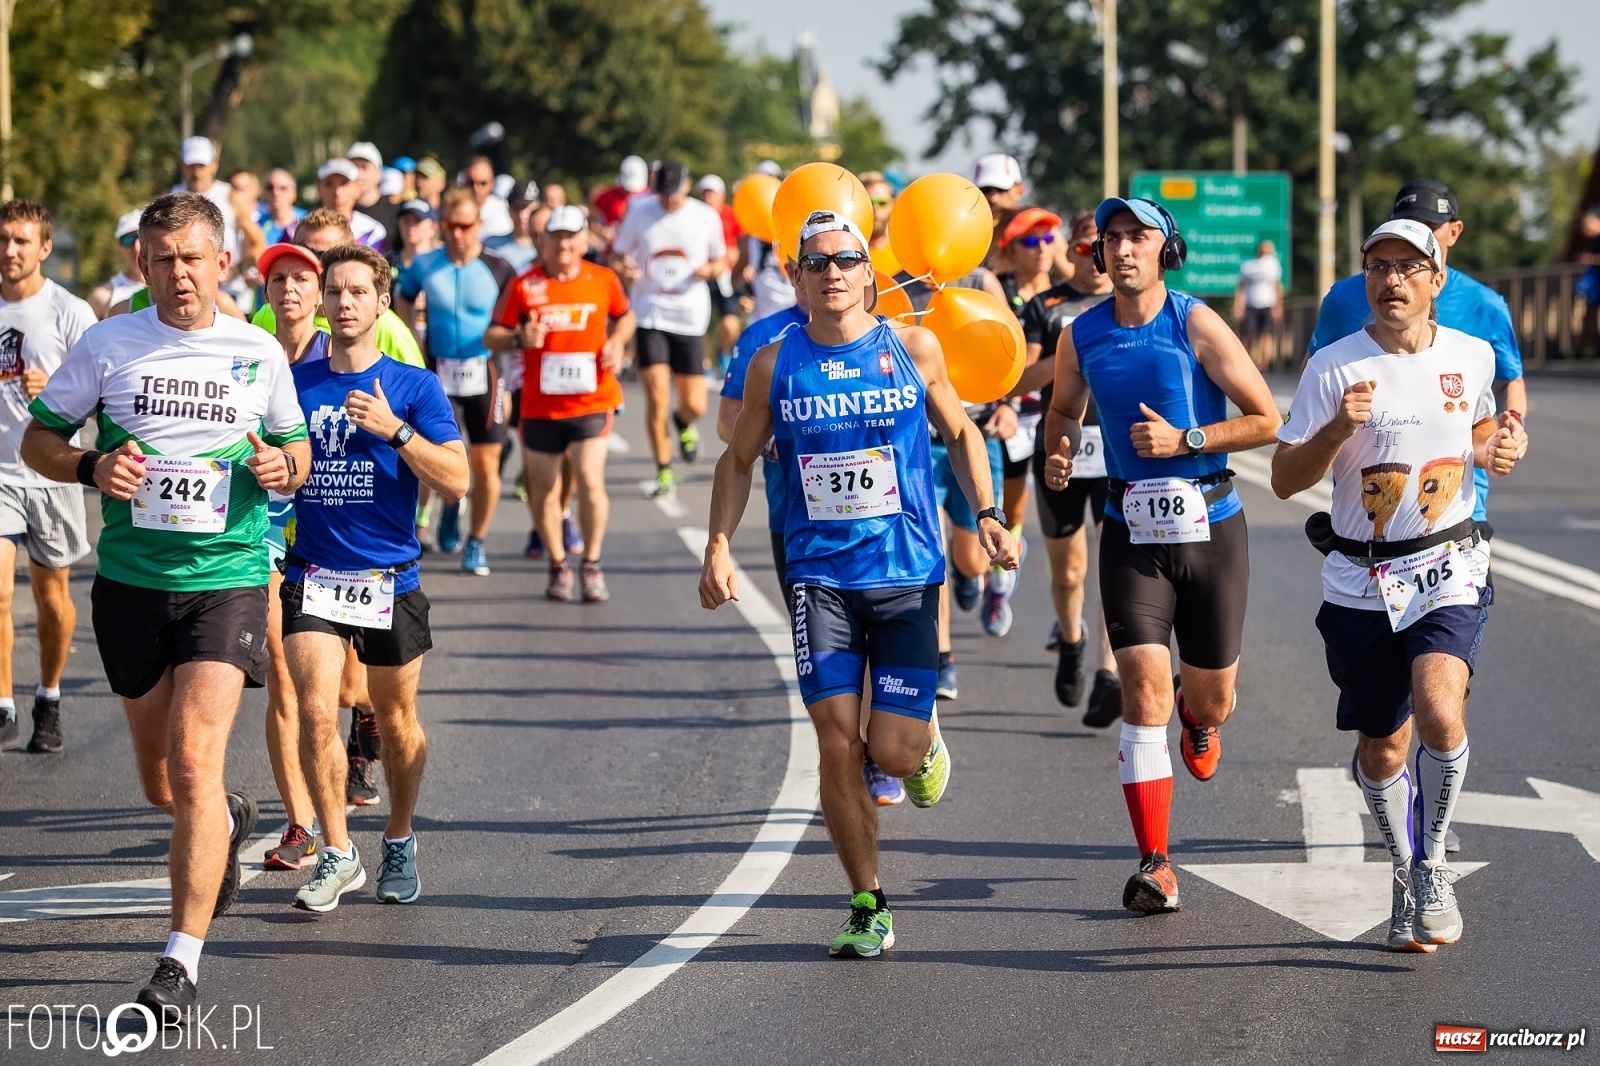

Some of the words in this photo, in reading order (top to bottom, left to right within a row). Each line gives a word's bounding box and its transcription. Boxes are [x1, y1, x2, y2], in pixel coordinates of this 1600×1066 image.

[141, 375, 199, 398] TEAM
[204, 380, 230, 400] OF
[133, 394, 238, 424] RUNNERS
[780, 384, 918, 422] RUNNERS
[863, 417, 895, 429] TEAM
[313, 460, 348, 472] WIZZ
[350, 460, 375, 473] AIR
[159, 476, 207, 502] 242
[829, 467, 875, 493] 376
[320, 488, 374, 498] MARATHON
[322, 497, 345, 506] 2019
[1147, 495, 1186, 519] 198
[1413, 559, 1454, 595] 105
[332, 583, 372, 606] 166
[793, 582, 813, 677] UNNERS
